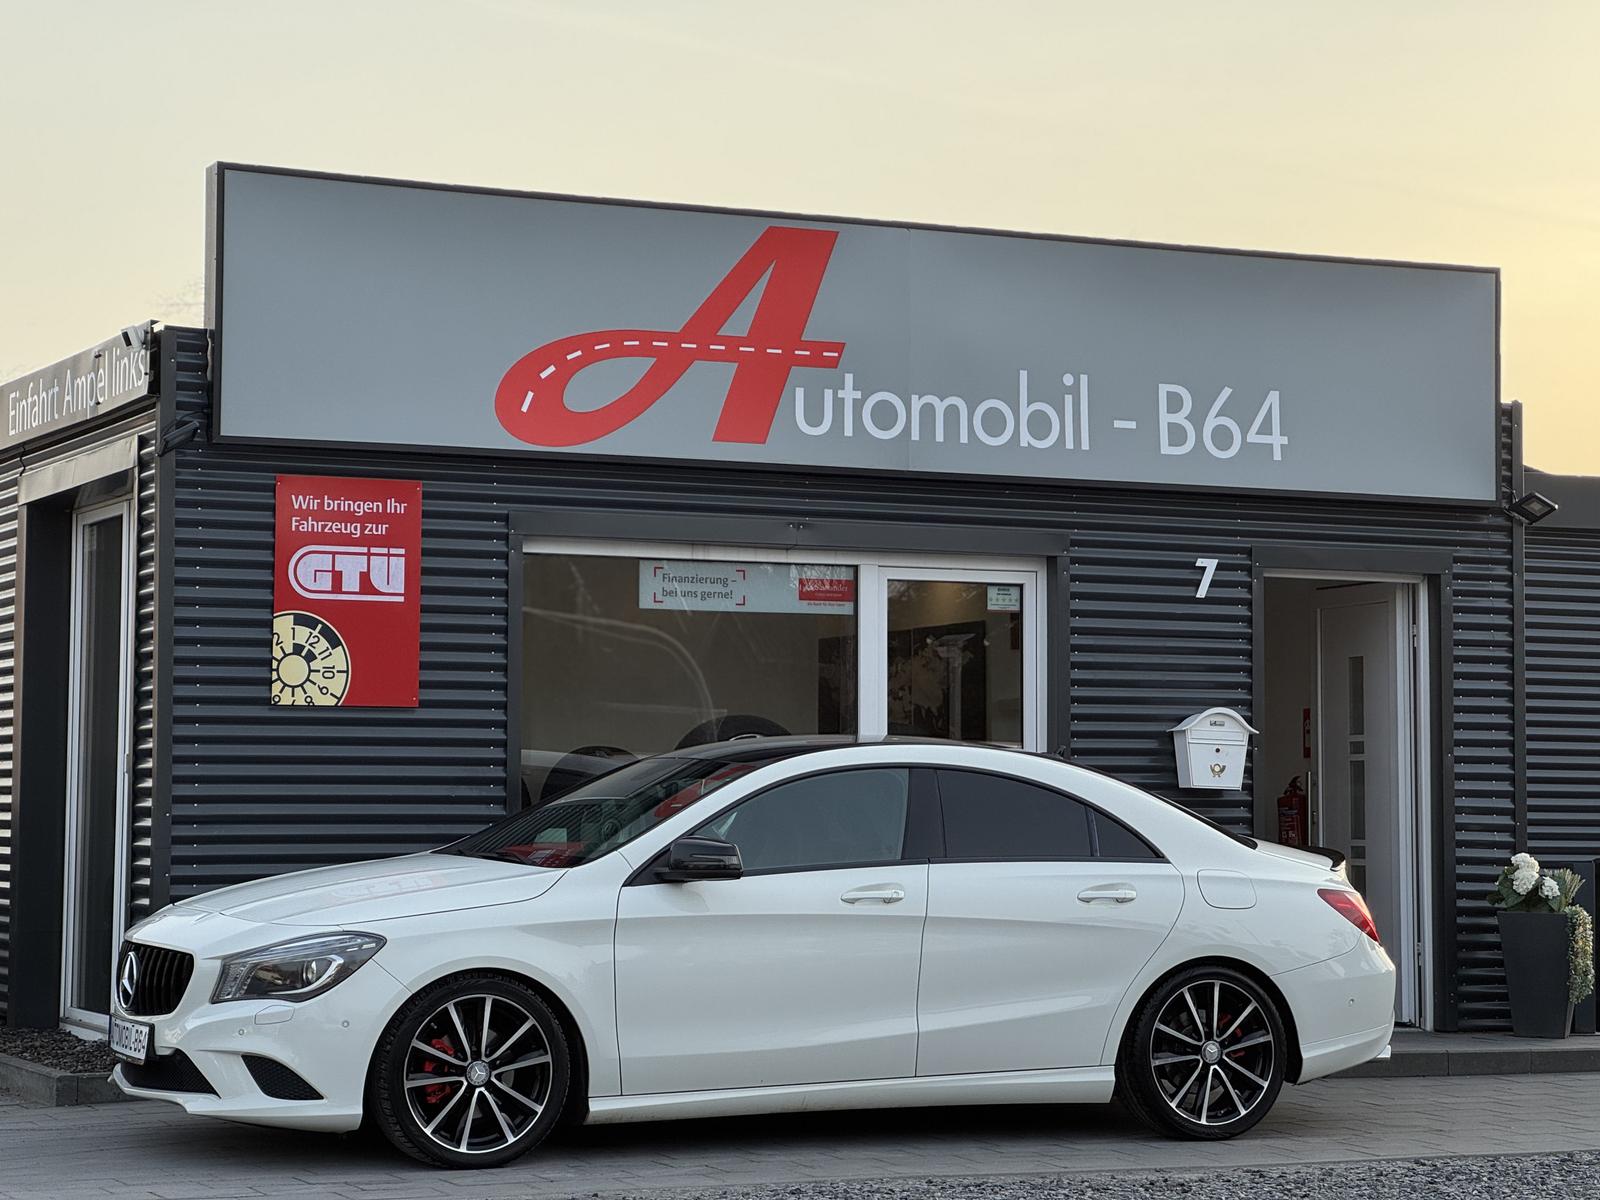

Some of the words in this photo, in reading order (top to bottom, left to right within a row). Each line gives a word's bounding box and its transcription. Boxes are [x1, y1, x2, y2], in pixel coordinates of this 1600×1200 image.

[494, 225, 1090, 450] Automobil
[1158, 383, 1289, 461] B64
[8, 378, 60, 437] Einfahrt
[62, 350, 108, 419] Ampel
[112, 347, 145, 397] links
[291, 495, 320, 510] Wir
[324, 495, 383, 516] bringen
[386, 498, 407, 514] Ihr
[291, 516, 361, 538] Fahrzeug
[364, 523, 389, 535] zur
[288, 545, 405, 602] GTÜ
[662, 573, 729, 588] Finanzierung
[1195, 558, 1219, 598] 7
[662, 587, 678, 598] bei
[680, 590, 698, 599] uns
[700, 590, 733, 602] gerne!
[305, 631, 320, 649] 12
[322, 665, 336, 679] 10
